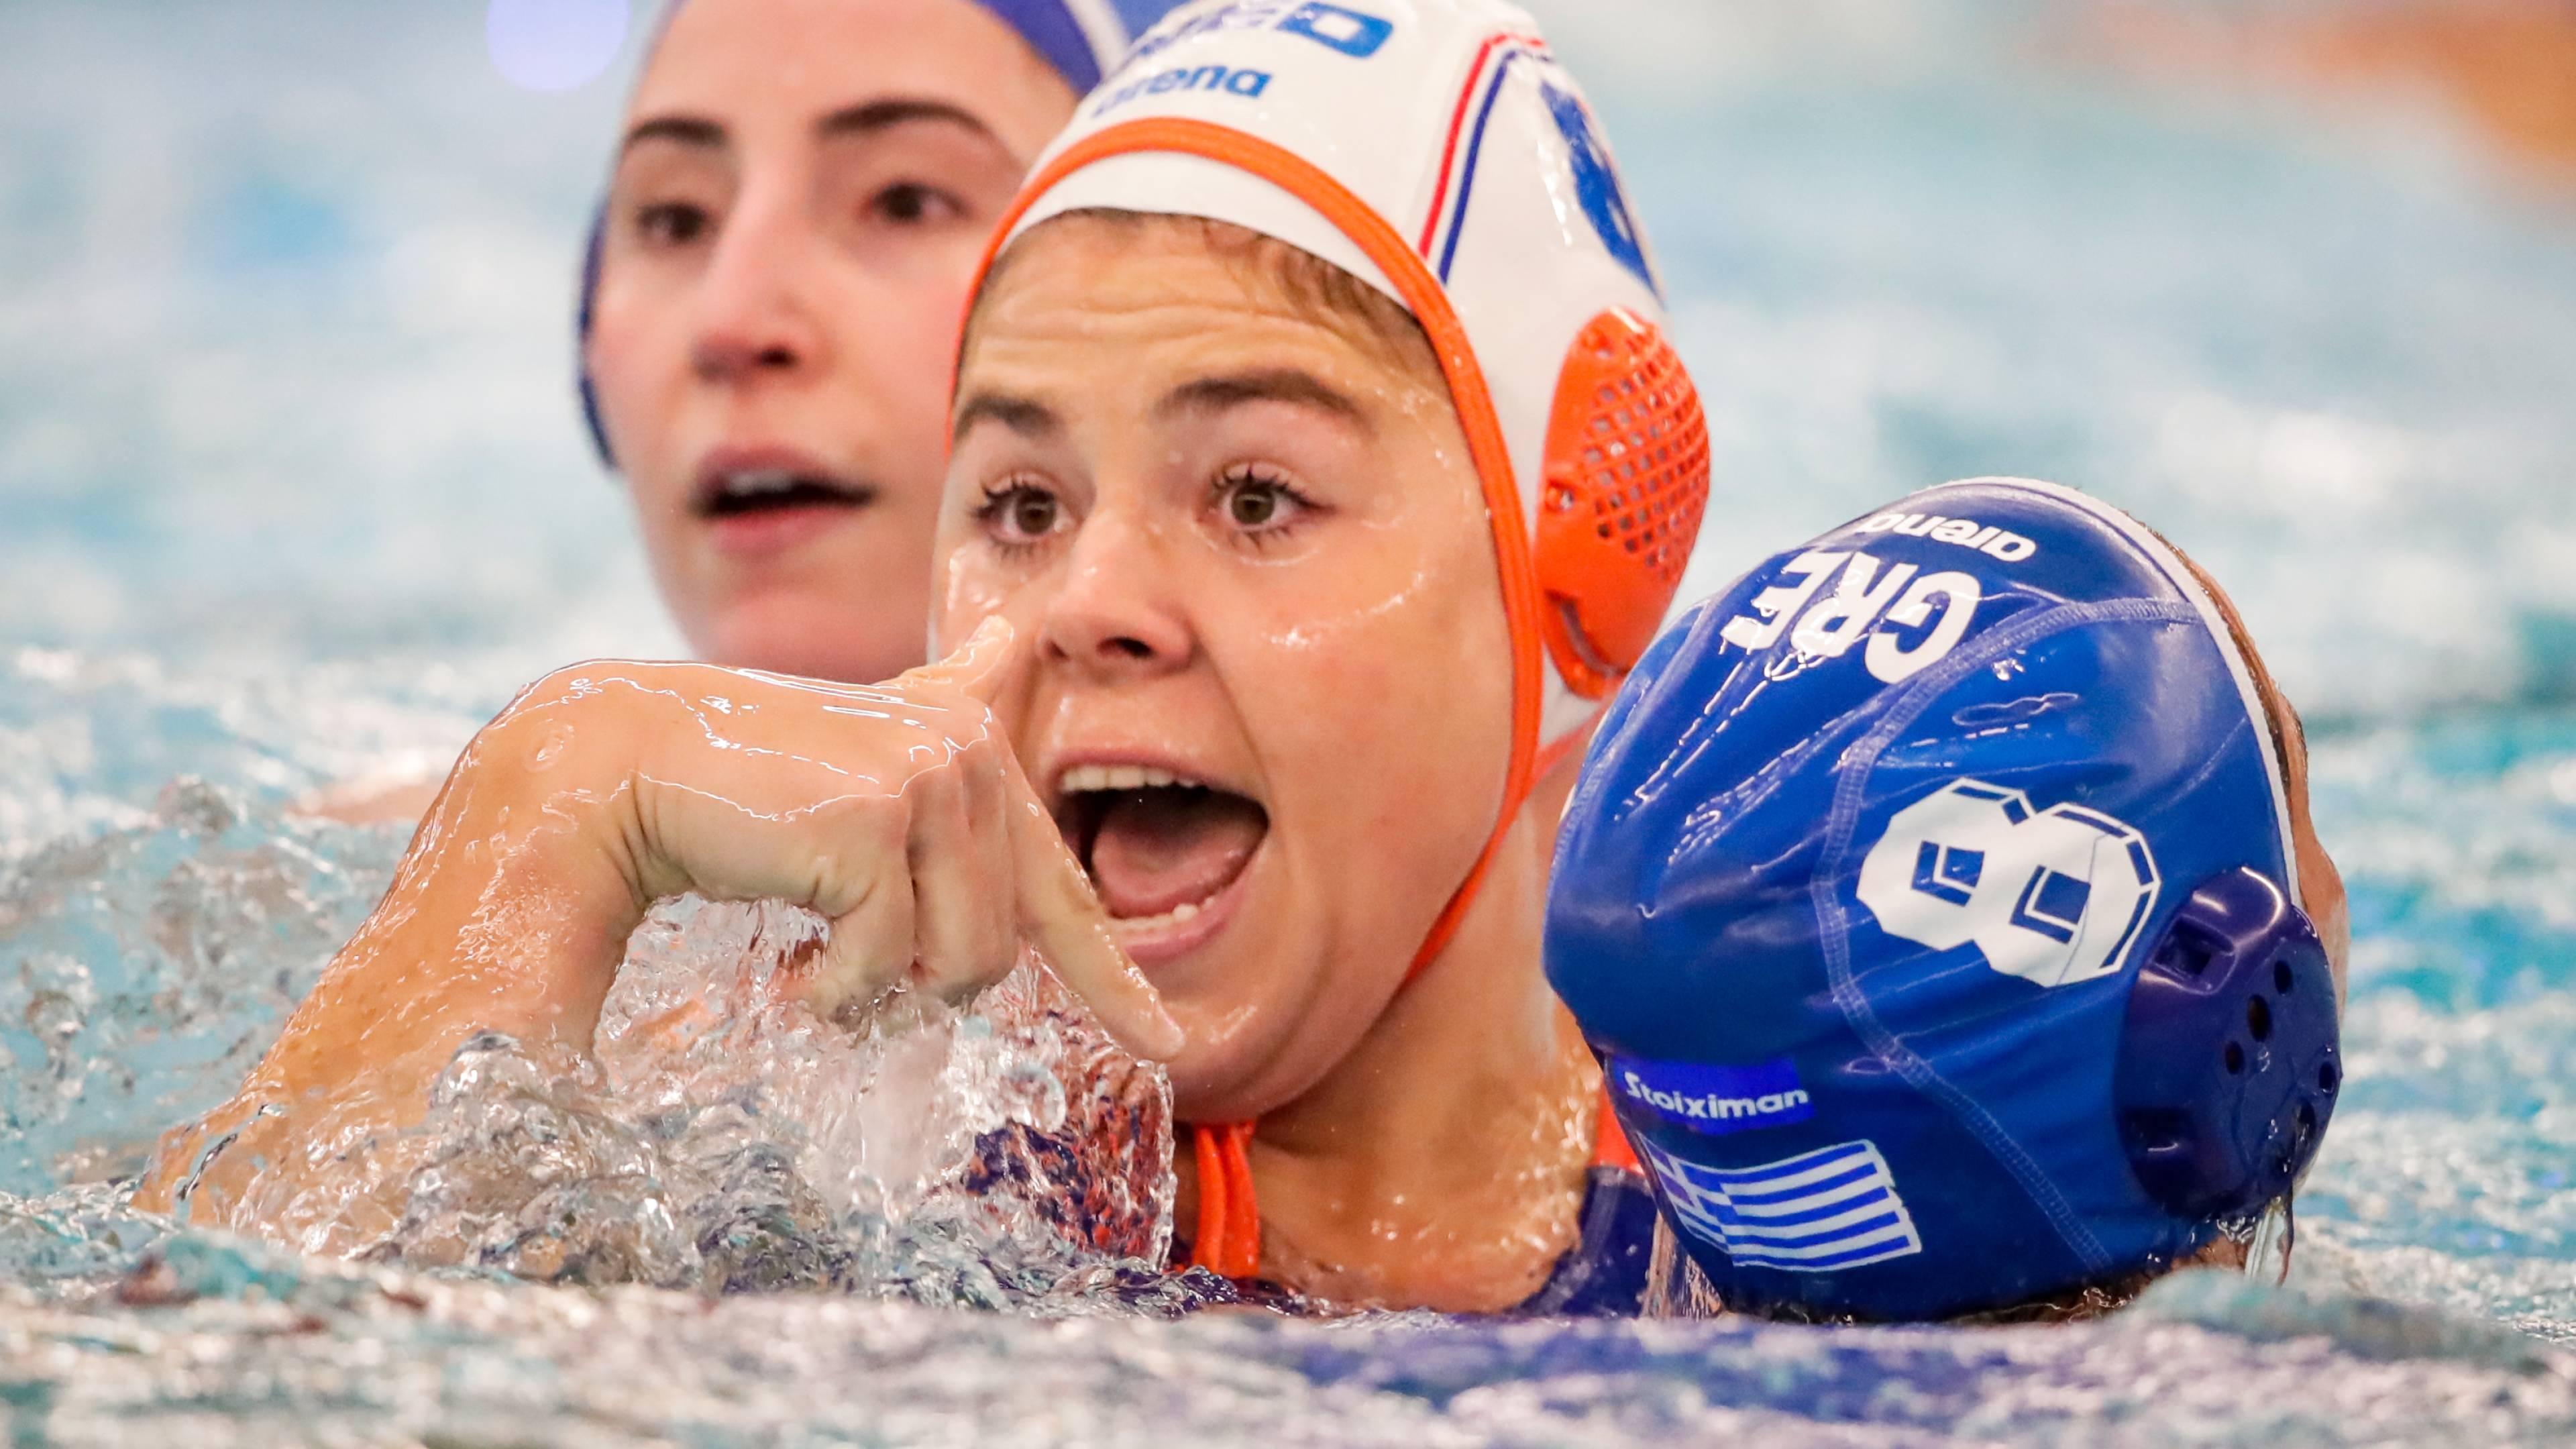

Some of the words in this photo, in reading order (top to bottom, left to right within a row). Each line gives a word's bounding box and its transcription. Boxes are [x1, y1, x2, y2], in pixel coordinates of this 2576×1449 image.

[1092, 66, 1272, 118] arena
[1854, 513, 2037, 562] arena
[1720, 551, 1981, 684] GRE
[1856, 777, 2161, 988] 8
[1624, 1071, 1809, 1119] Stoiximan
